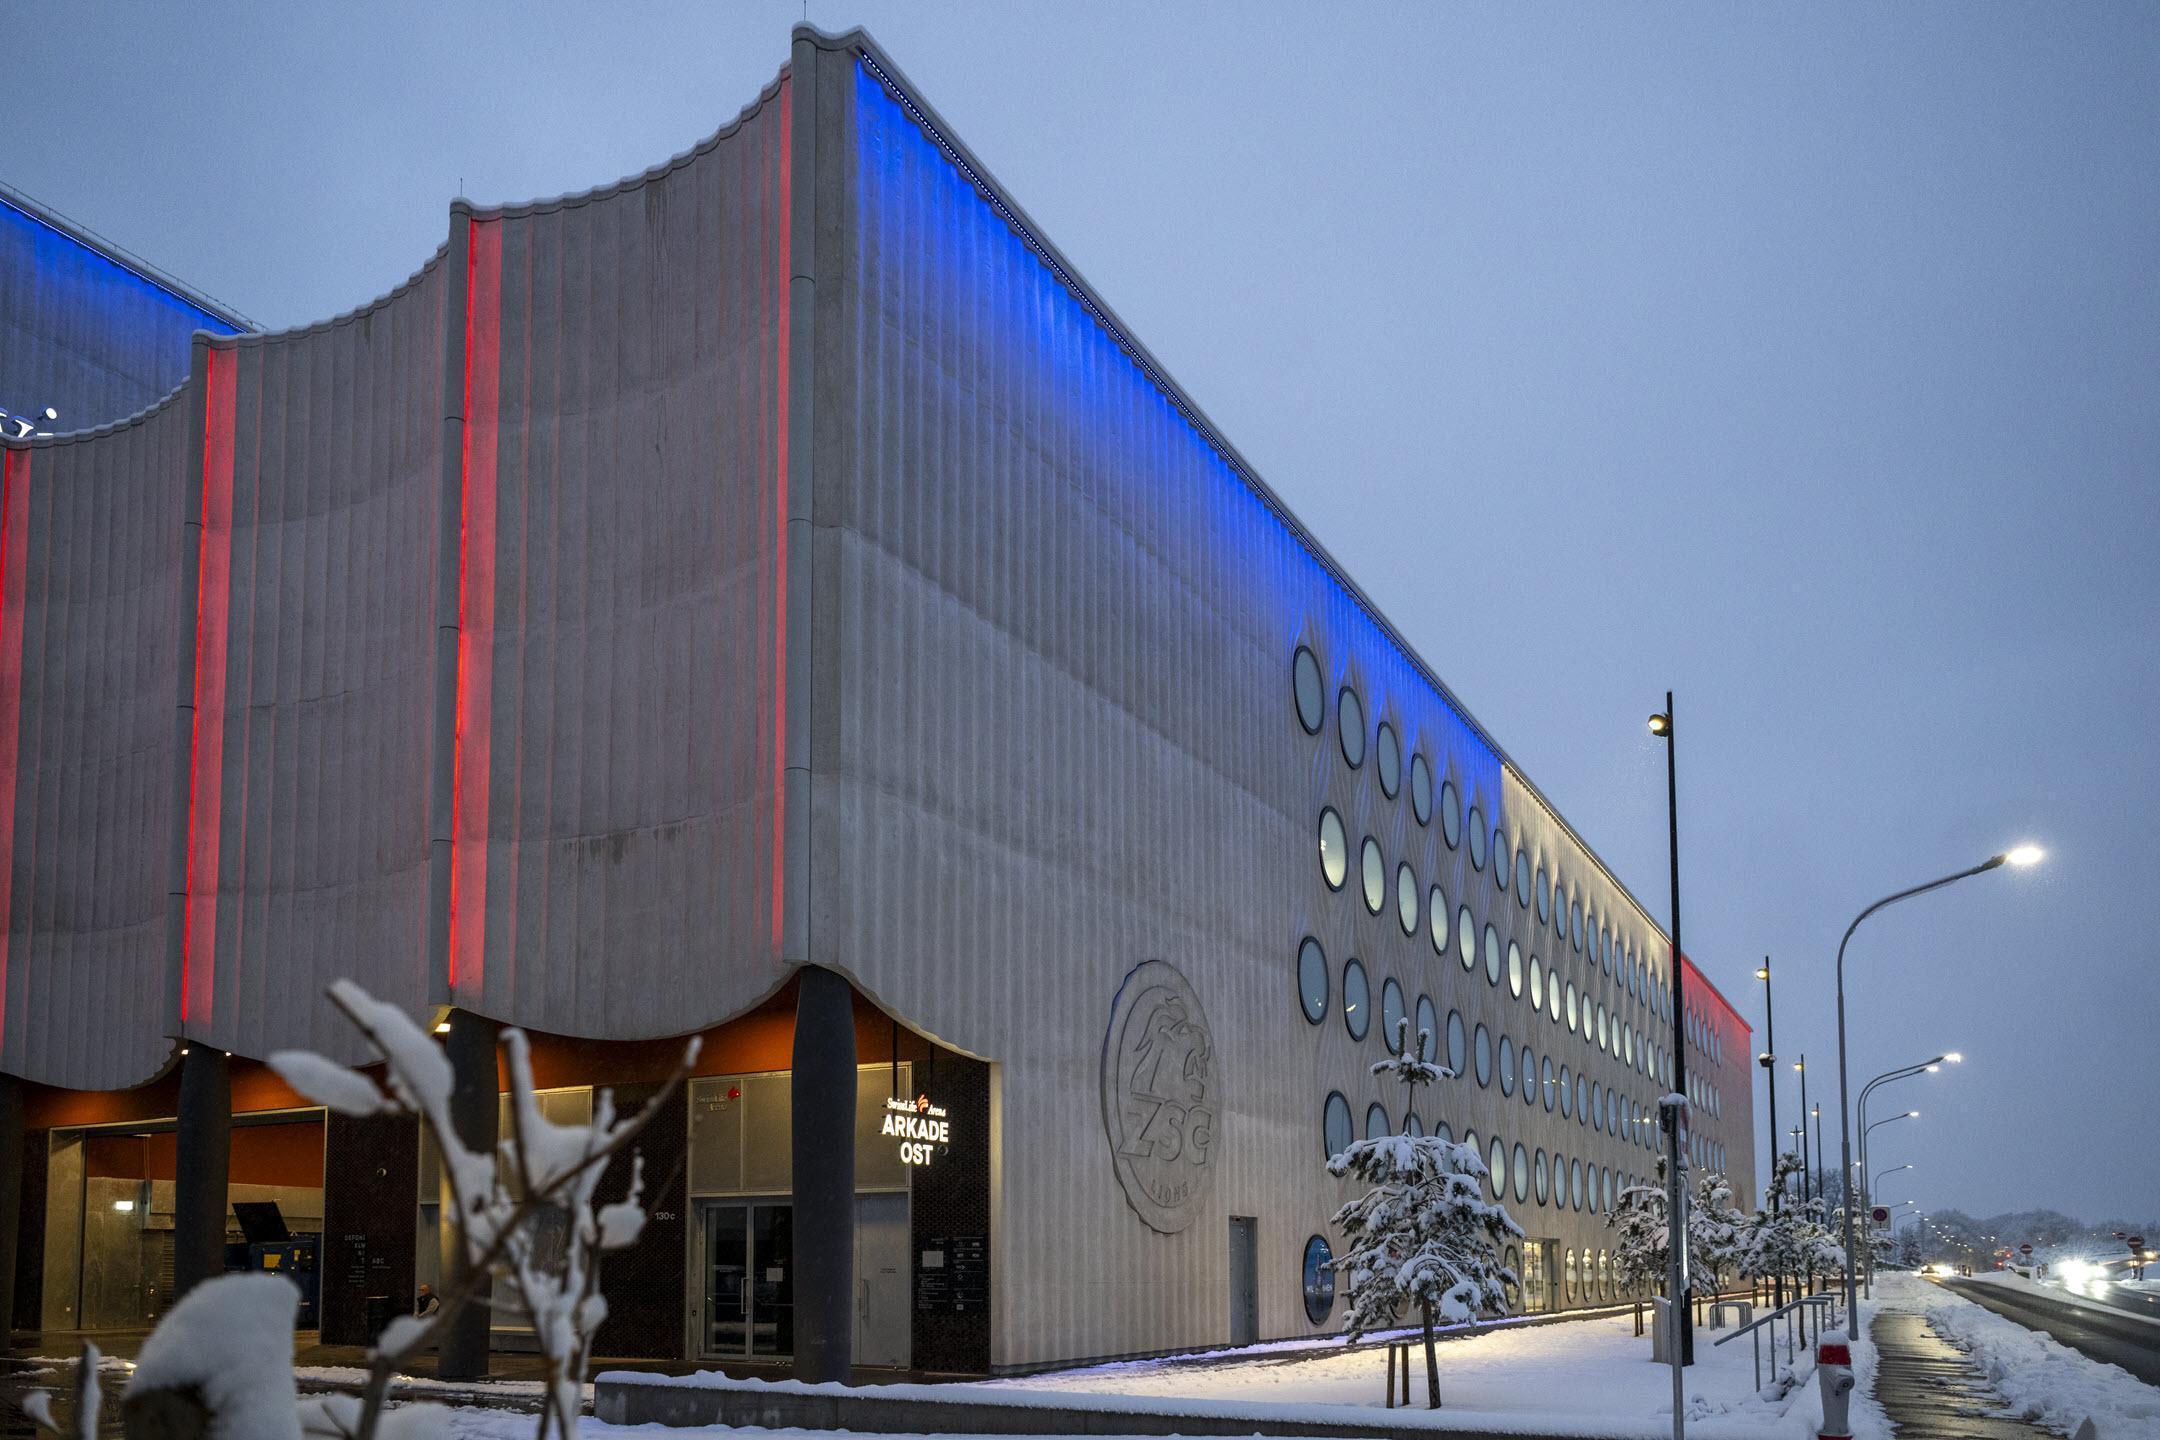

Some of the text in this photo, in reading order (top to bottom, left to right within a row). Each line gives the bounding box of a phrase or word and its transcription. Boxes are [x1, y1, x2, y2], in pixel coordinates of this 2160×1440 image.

[927, 1104, 946, 1117] Arena
[881, 1113, 949, 1142] ARKADE
[1116, 1092, 1212, 1166] ZSC
[900, 1141, 933, 1165] OST
[1151, 1179, 1188, 1203] LIONS
